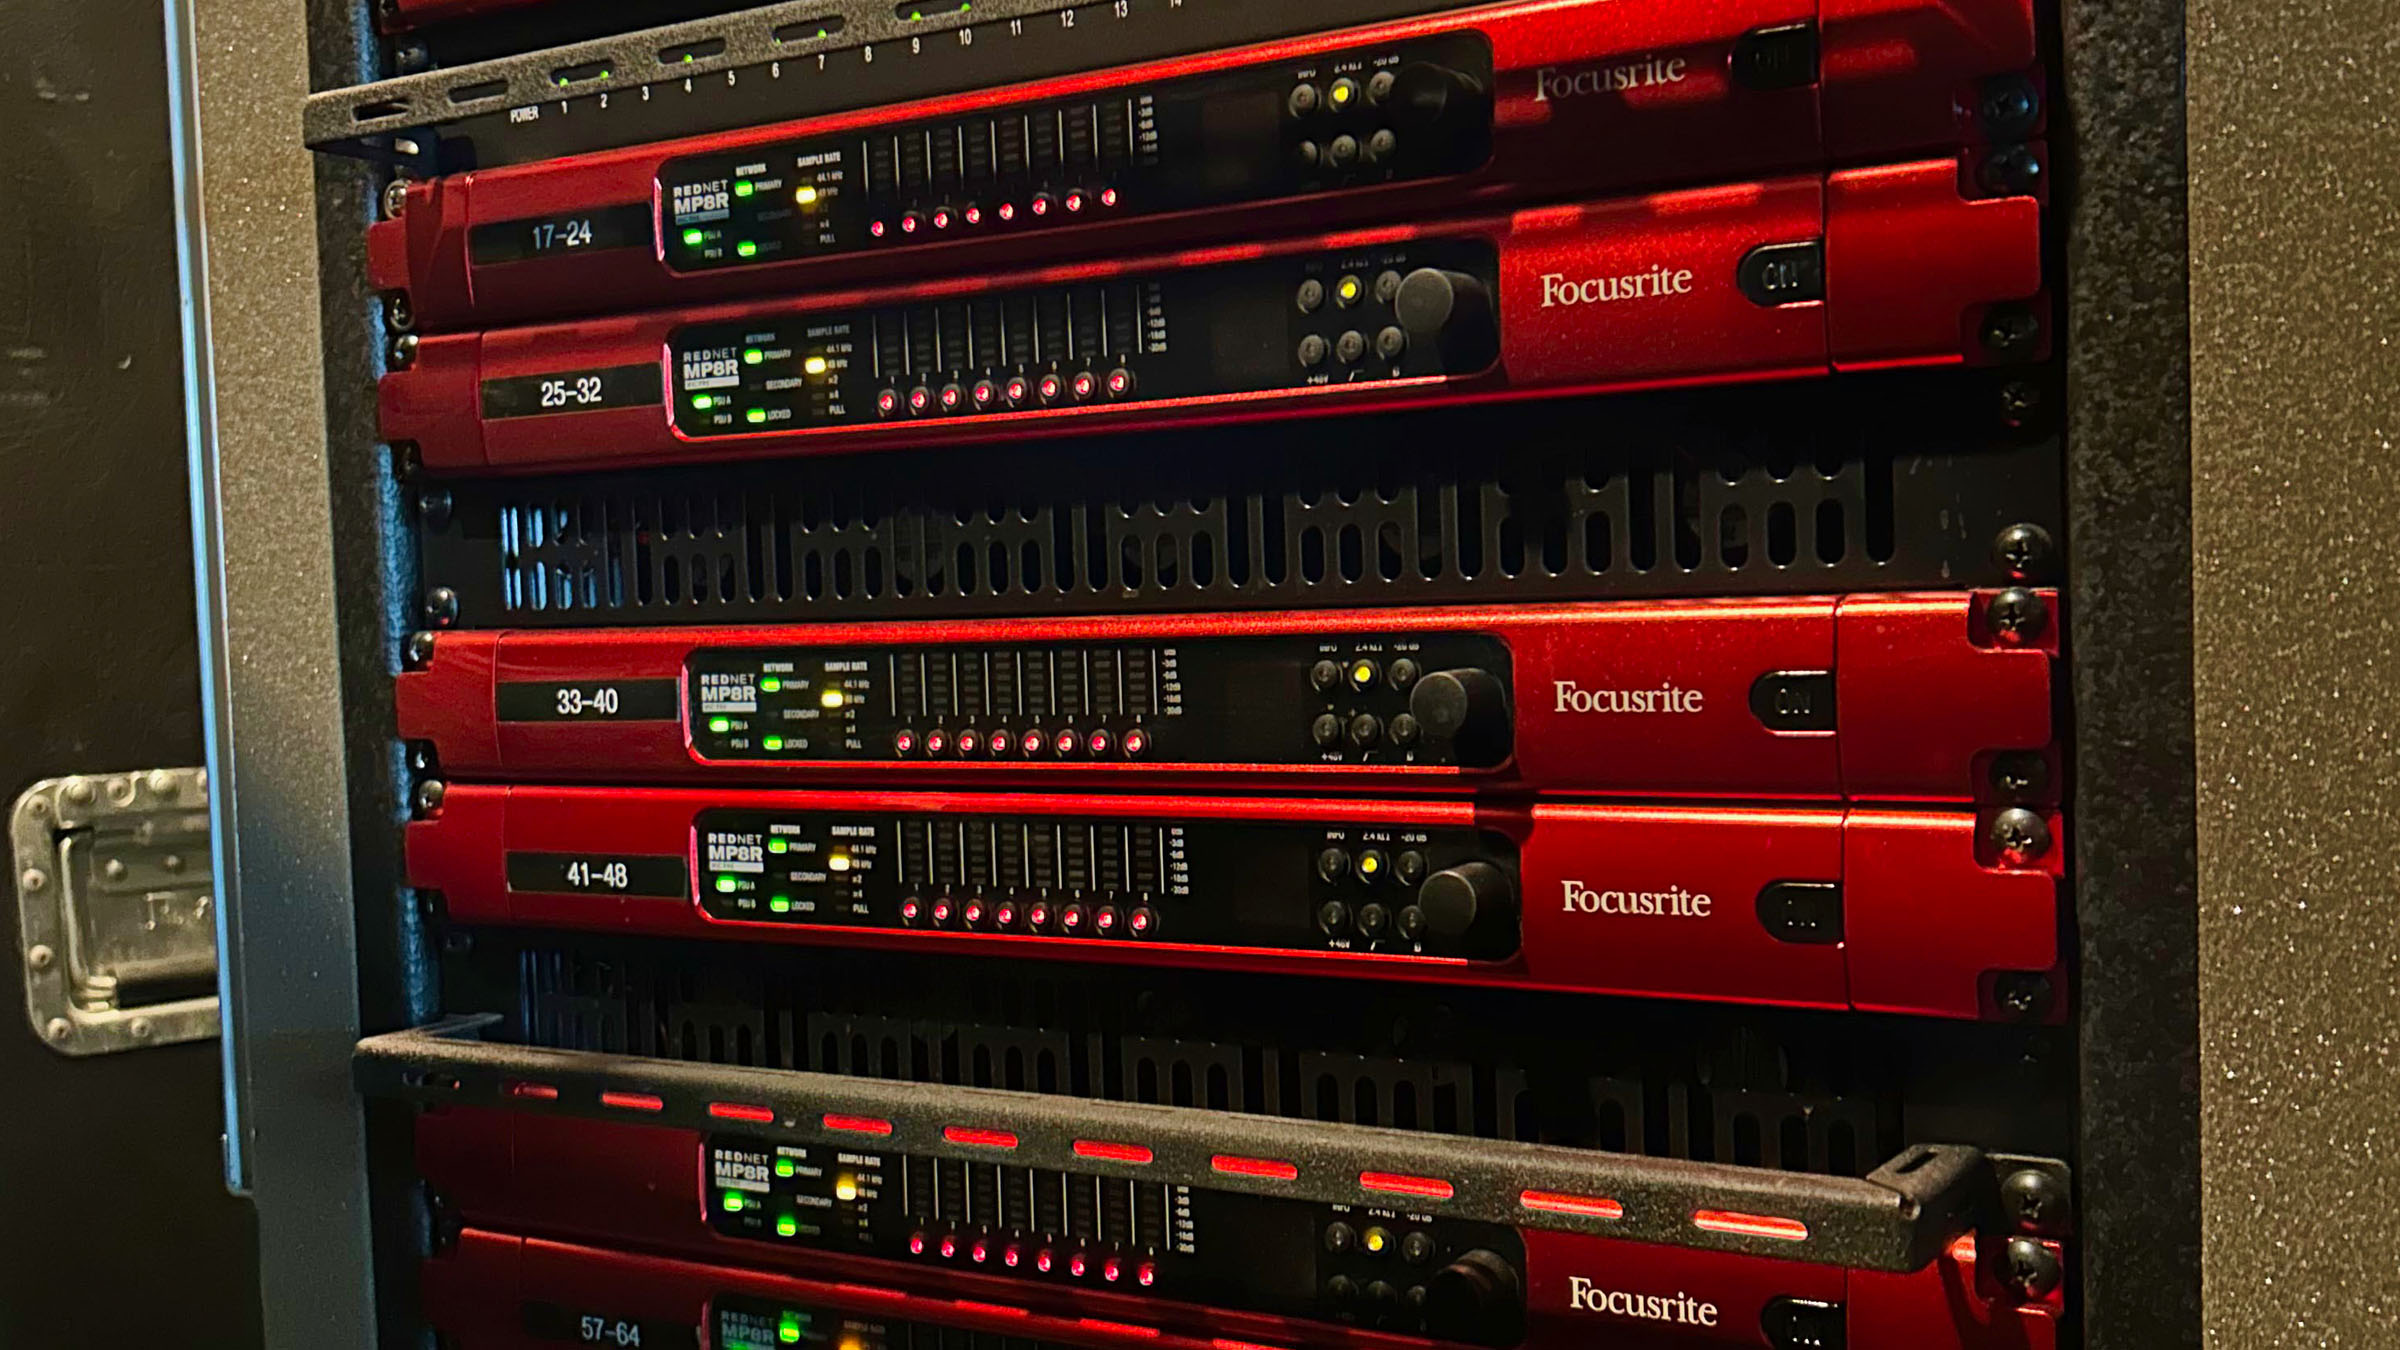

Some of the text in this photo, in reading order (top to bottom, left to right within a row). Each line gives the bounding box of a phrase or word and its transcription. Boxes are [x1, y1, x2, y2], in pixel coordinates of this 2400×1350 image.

[510, 0, 1128, 124] POWER 1 2 3 4 5 6 7 8 9 10 11 12 13
[1536, 55, 1686, 102] Focusrite
[673, 179, 728, 198] REDNET
[674, 192, 728, 214] MP8R
[533, 220, 592, 249] 17-24
[1540, 264, 1692, 308] Focusrite
[684, 347, 738, 362] REDNET
[684, 360, 738, 380] MP8R
[541, 376, 602, 407] 25-32
[701, 674, 755, 685] REDNET
[557, 688, 618, 714] 33-40
[702, 686, 756, 702] MP8R
[1554, 681, 1703, 713] Focusrite
[708, 833, 762, 845] REDNET
[708, 846, 763, 862] MP8R
[567, 862, 628, 888] 41-48
[1561, 880, 1712, 917] Focusrite
[714, 1150, 768, 1165] REDNET
[716, 1162, 769, 1182] MP8R
[1569, 1276, 1718, 1326] Focusrite
[721, 1310, 774, 1326] REDNET
[580, 1316, 641, 1347] 57-64
[722, 1322, 775, 1343] MP8R
